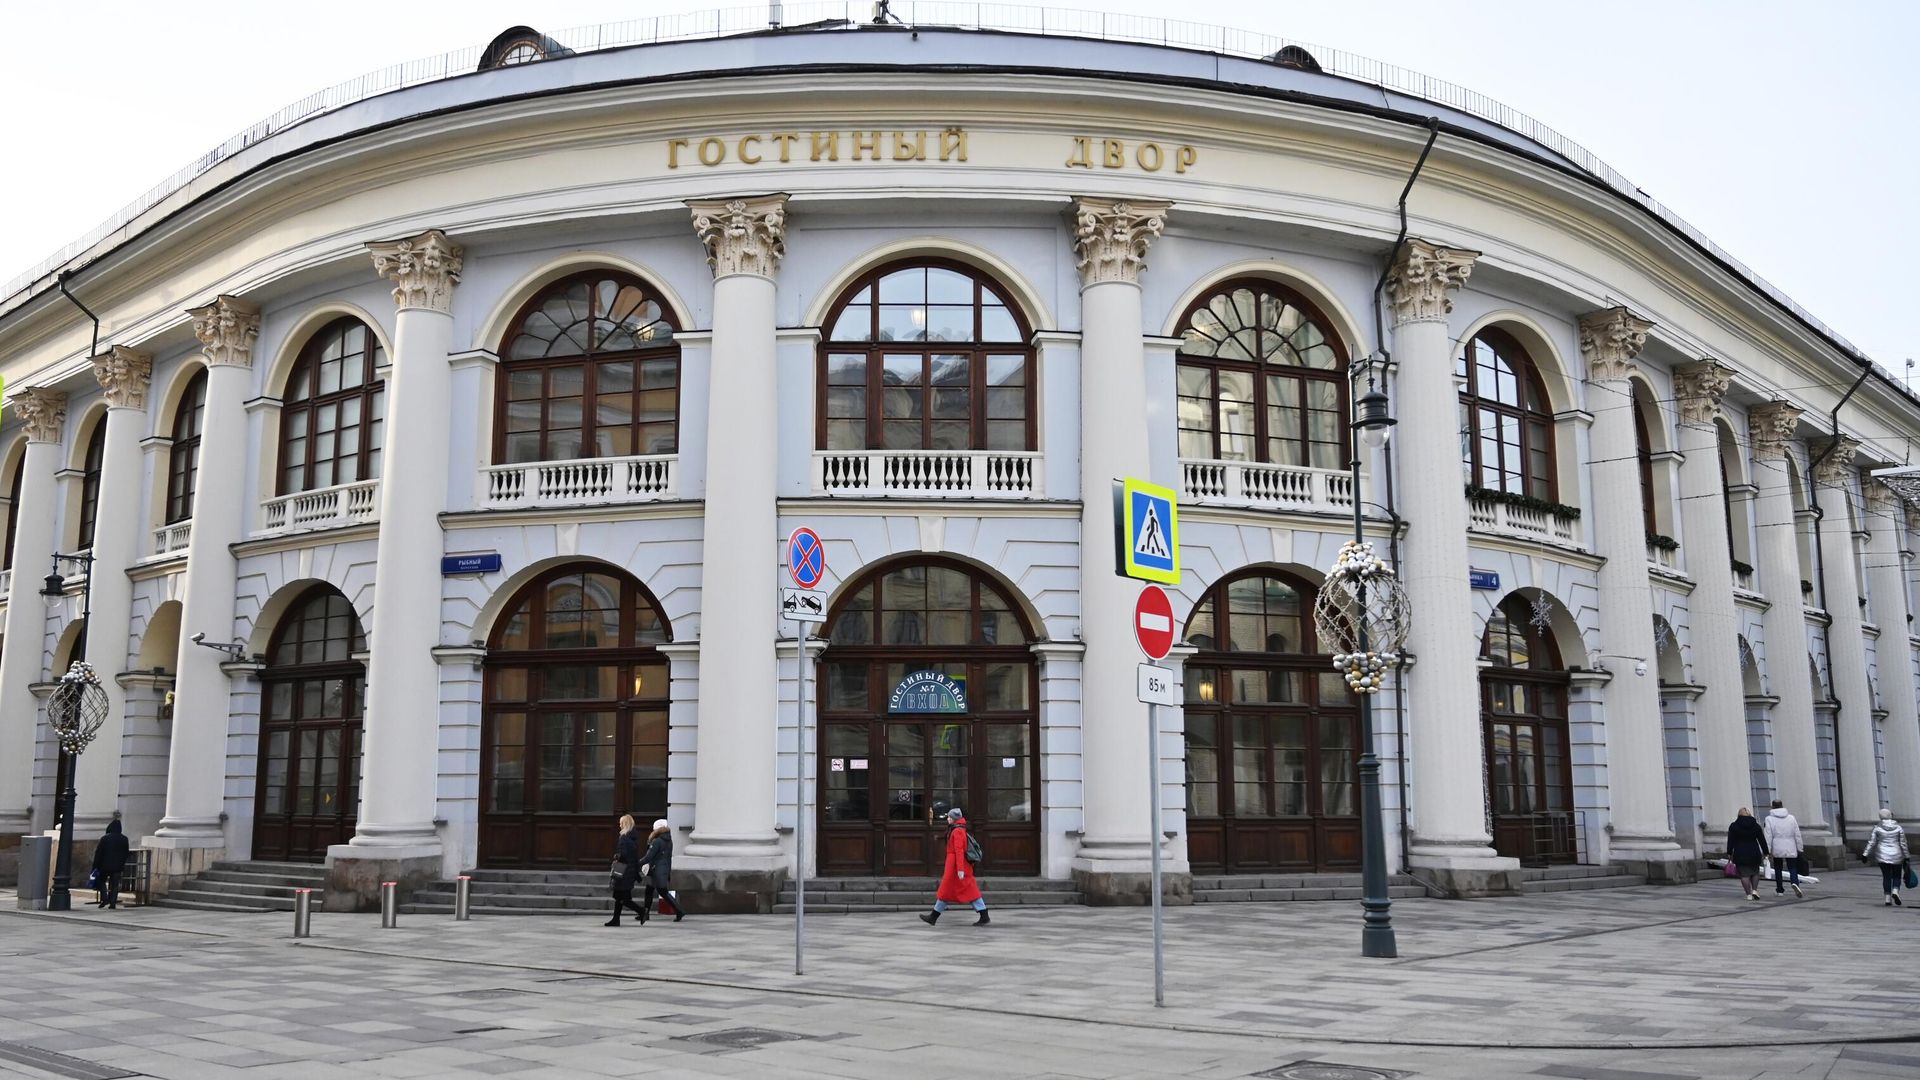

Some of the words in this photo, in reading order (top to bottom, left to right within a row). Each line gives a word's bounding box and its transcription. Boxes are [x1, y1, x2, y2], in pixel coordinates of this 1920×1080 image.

[667, 127, 969, 168] ГОСТИНЫЙ
[1065, 137, 1198, 173] ДВОР
[1492, 576, 1496, 586] 4
[890, 672, 945, 709] ГОСТИНЫЙ
[945, 681, 966, 709] ДВОР
[906, 693, 950, 709] ВХОД
